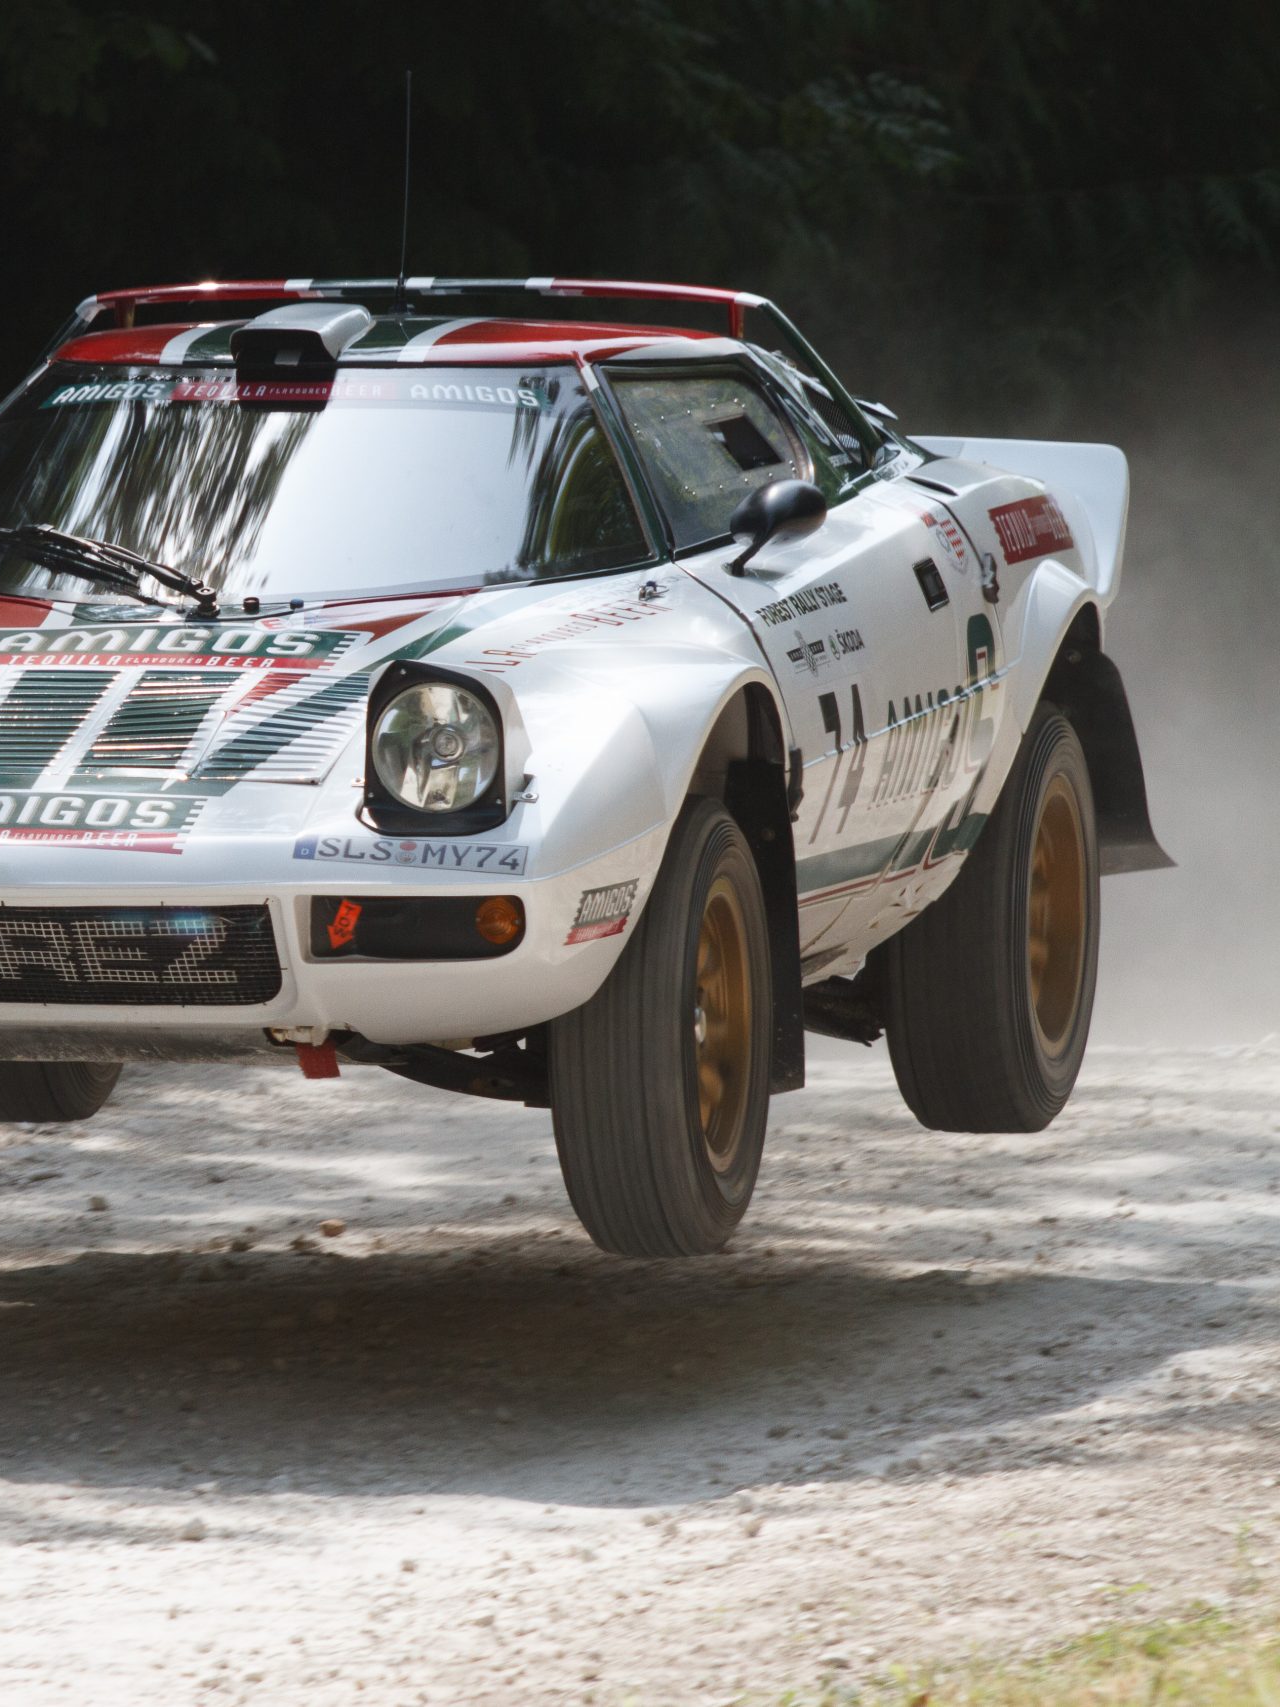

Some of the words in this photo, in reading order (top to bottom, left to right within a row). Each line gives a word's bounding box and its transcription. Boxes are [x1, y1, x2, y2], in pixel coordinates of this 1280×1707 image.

[52, 383, 164, 405] AMIGOS
[410, 384, 540, 407] AMIGOS
[754, 598, 797, 628] FOREST
[787, 588, 822, 616] RALLY
[813, 582, 848, 608] STAGE
[8, 653, 122, 668] TEQUILA
[124, 656, 204, 666] FLAVOURED
[205, 656, 276, 669] BEER
[80, 831, 139, 848] BEER
[318, 837, 394, 862] SLS
[578, 884, 634, 923] AMIGOS
